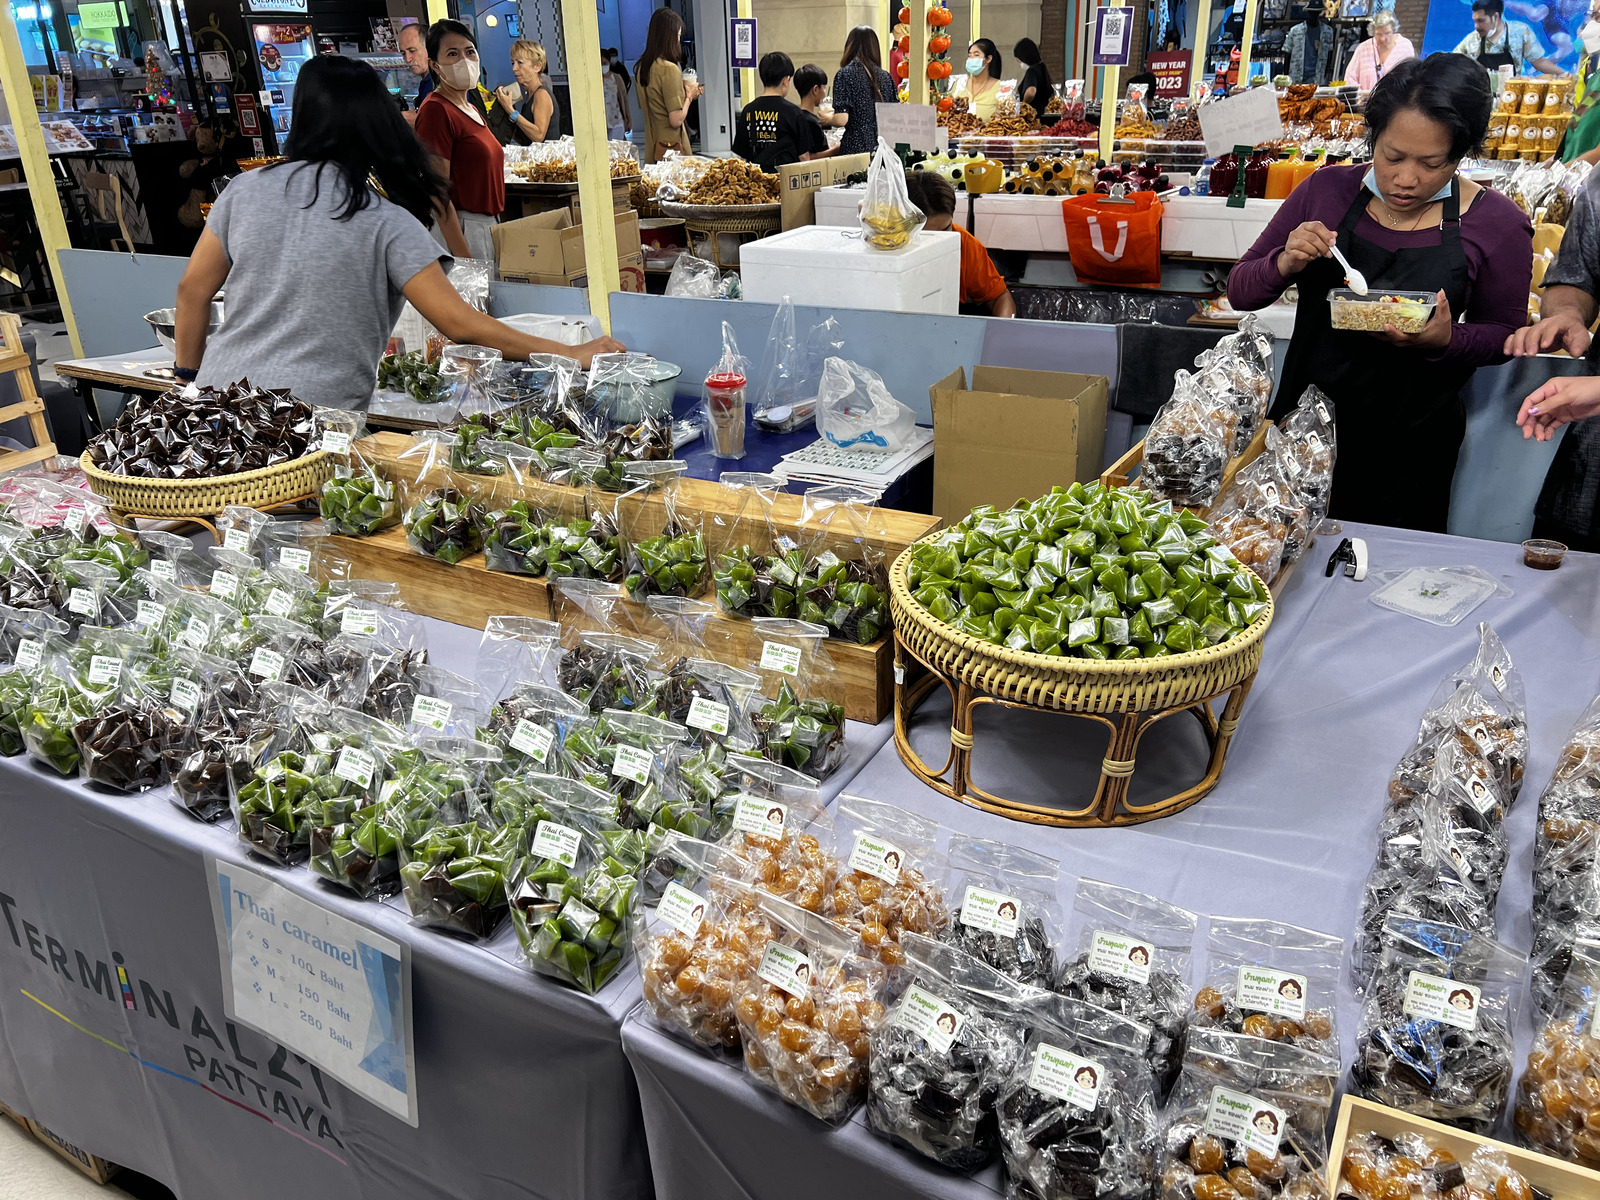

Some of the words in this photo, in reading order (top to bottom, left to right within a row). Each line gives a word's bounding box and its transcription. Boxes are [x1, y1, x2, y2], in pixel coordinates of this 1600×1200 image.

[1169, 61, 1186, 69] YEAR
[542, 825, 557, 834] Thai
[234, 889, 277, 927] Thai
[282, 918, 359, 970] caramel
[262, 938, 269, 949] S
[291, 954, 315, 975] 100
[321, 970, 345, 992] Baht
[1244, 972, 1276, 984] บ้านคุณย่า
[1414, 979, 1447, 993] บ้านคุณย่า
[267, 965, 276, 979] M
[298, 983, 320, 1003] 150
[327, 1000, 351, 1023] Baht
[270, 992, 277, 1004] L
[300, 1010, 322, 1031] 280
[329, 1027, 353, 1050] Baht
[1042, 1052, 1074, 1070] บ้านคุณย่า
[183, 1043, 345, 1149] PATTAYA
[1217, 1095, 1252, 1112] บ้านคุณย่า
